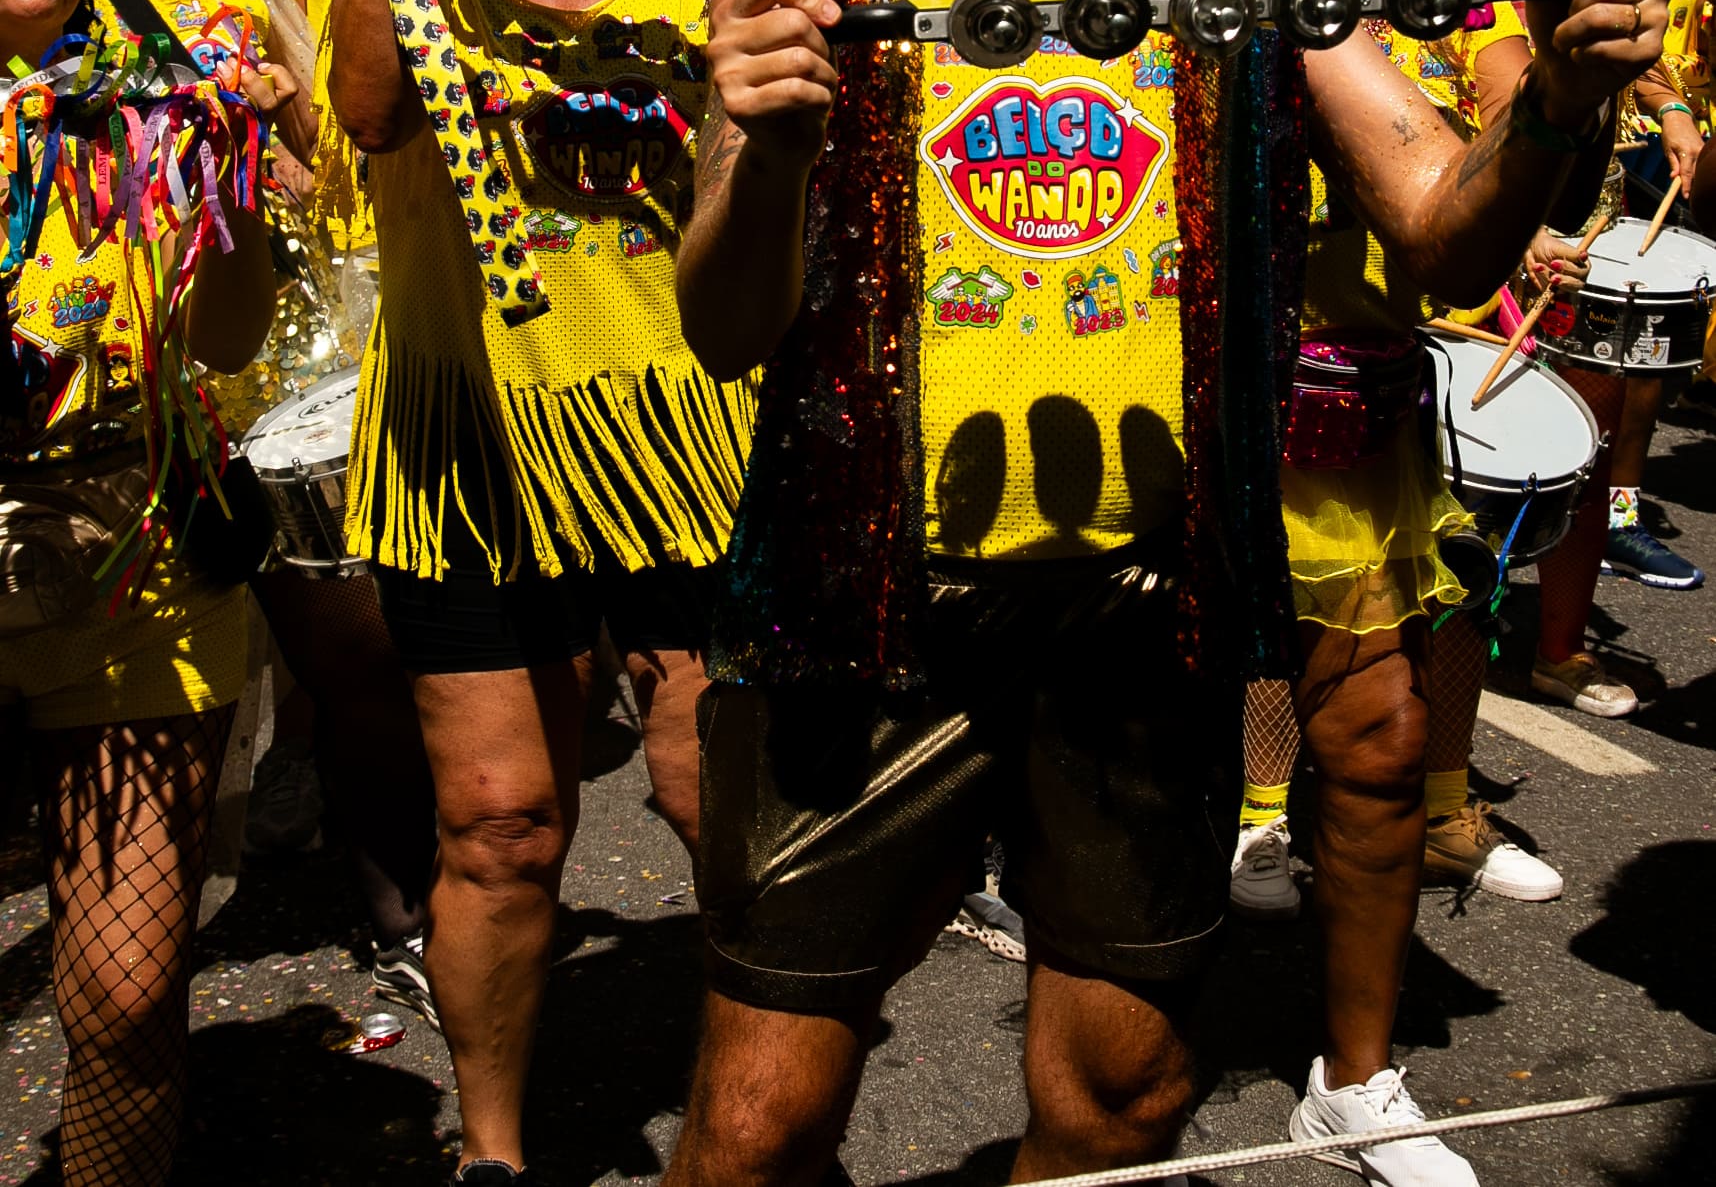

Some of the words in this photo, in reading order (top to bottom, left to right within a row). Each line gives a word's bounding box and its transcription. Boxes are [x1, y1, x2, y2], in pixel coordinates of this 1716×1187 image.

[968, 167, 1123, 230] WANDO
[1015, 220, 1036, 239] 10
[1036, 221, 1080, 239] anos
[55, 300, 108, 327] 2020
[939, 302, 1000, 323] 2024
[1073, 310, 1125, 335] 2023
